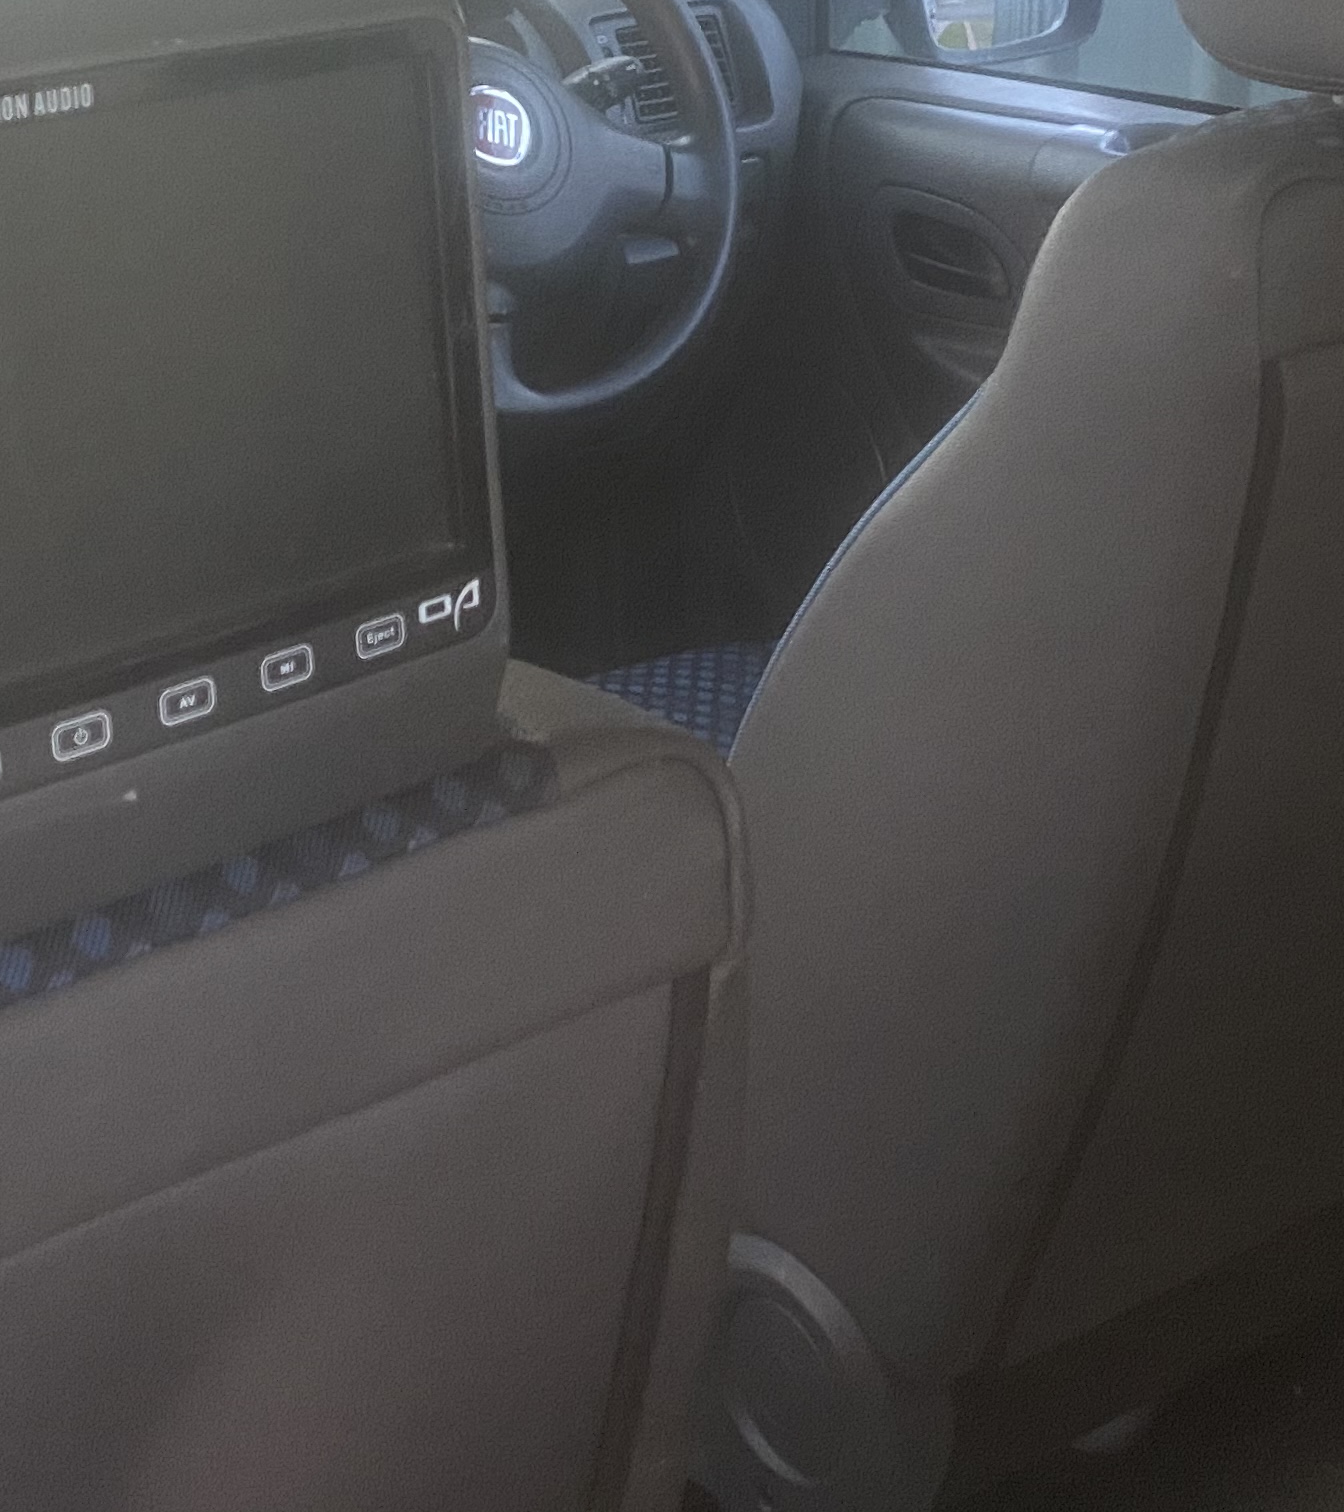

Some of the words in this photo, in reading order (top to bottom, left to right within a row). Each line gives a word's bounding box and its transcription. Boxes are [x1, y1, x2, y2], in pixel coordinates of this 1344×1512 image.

[33, 83, 94, 116] AUDIO
[478, 106, 518, 148] FIAT
[366, 626, 395, 645] Eject
[179, 694, 196, 709] AV
